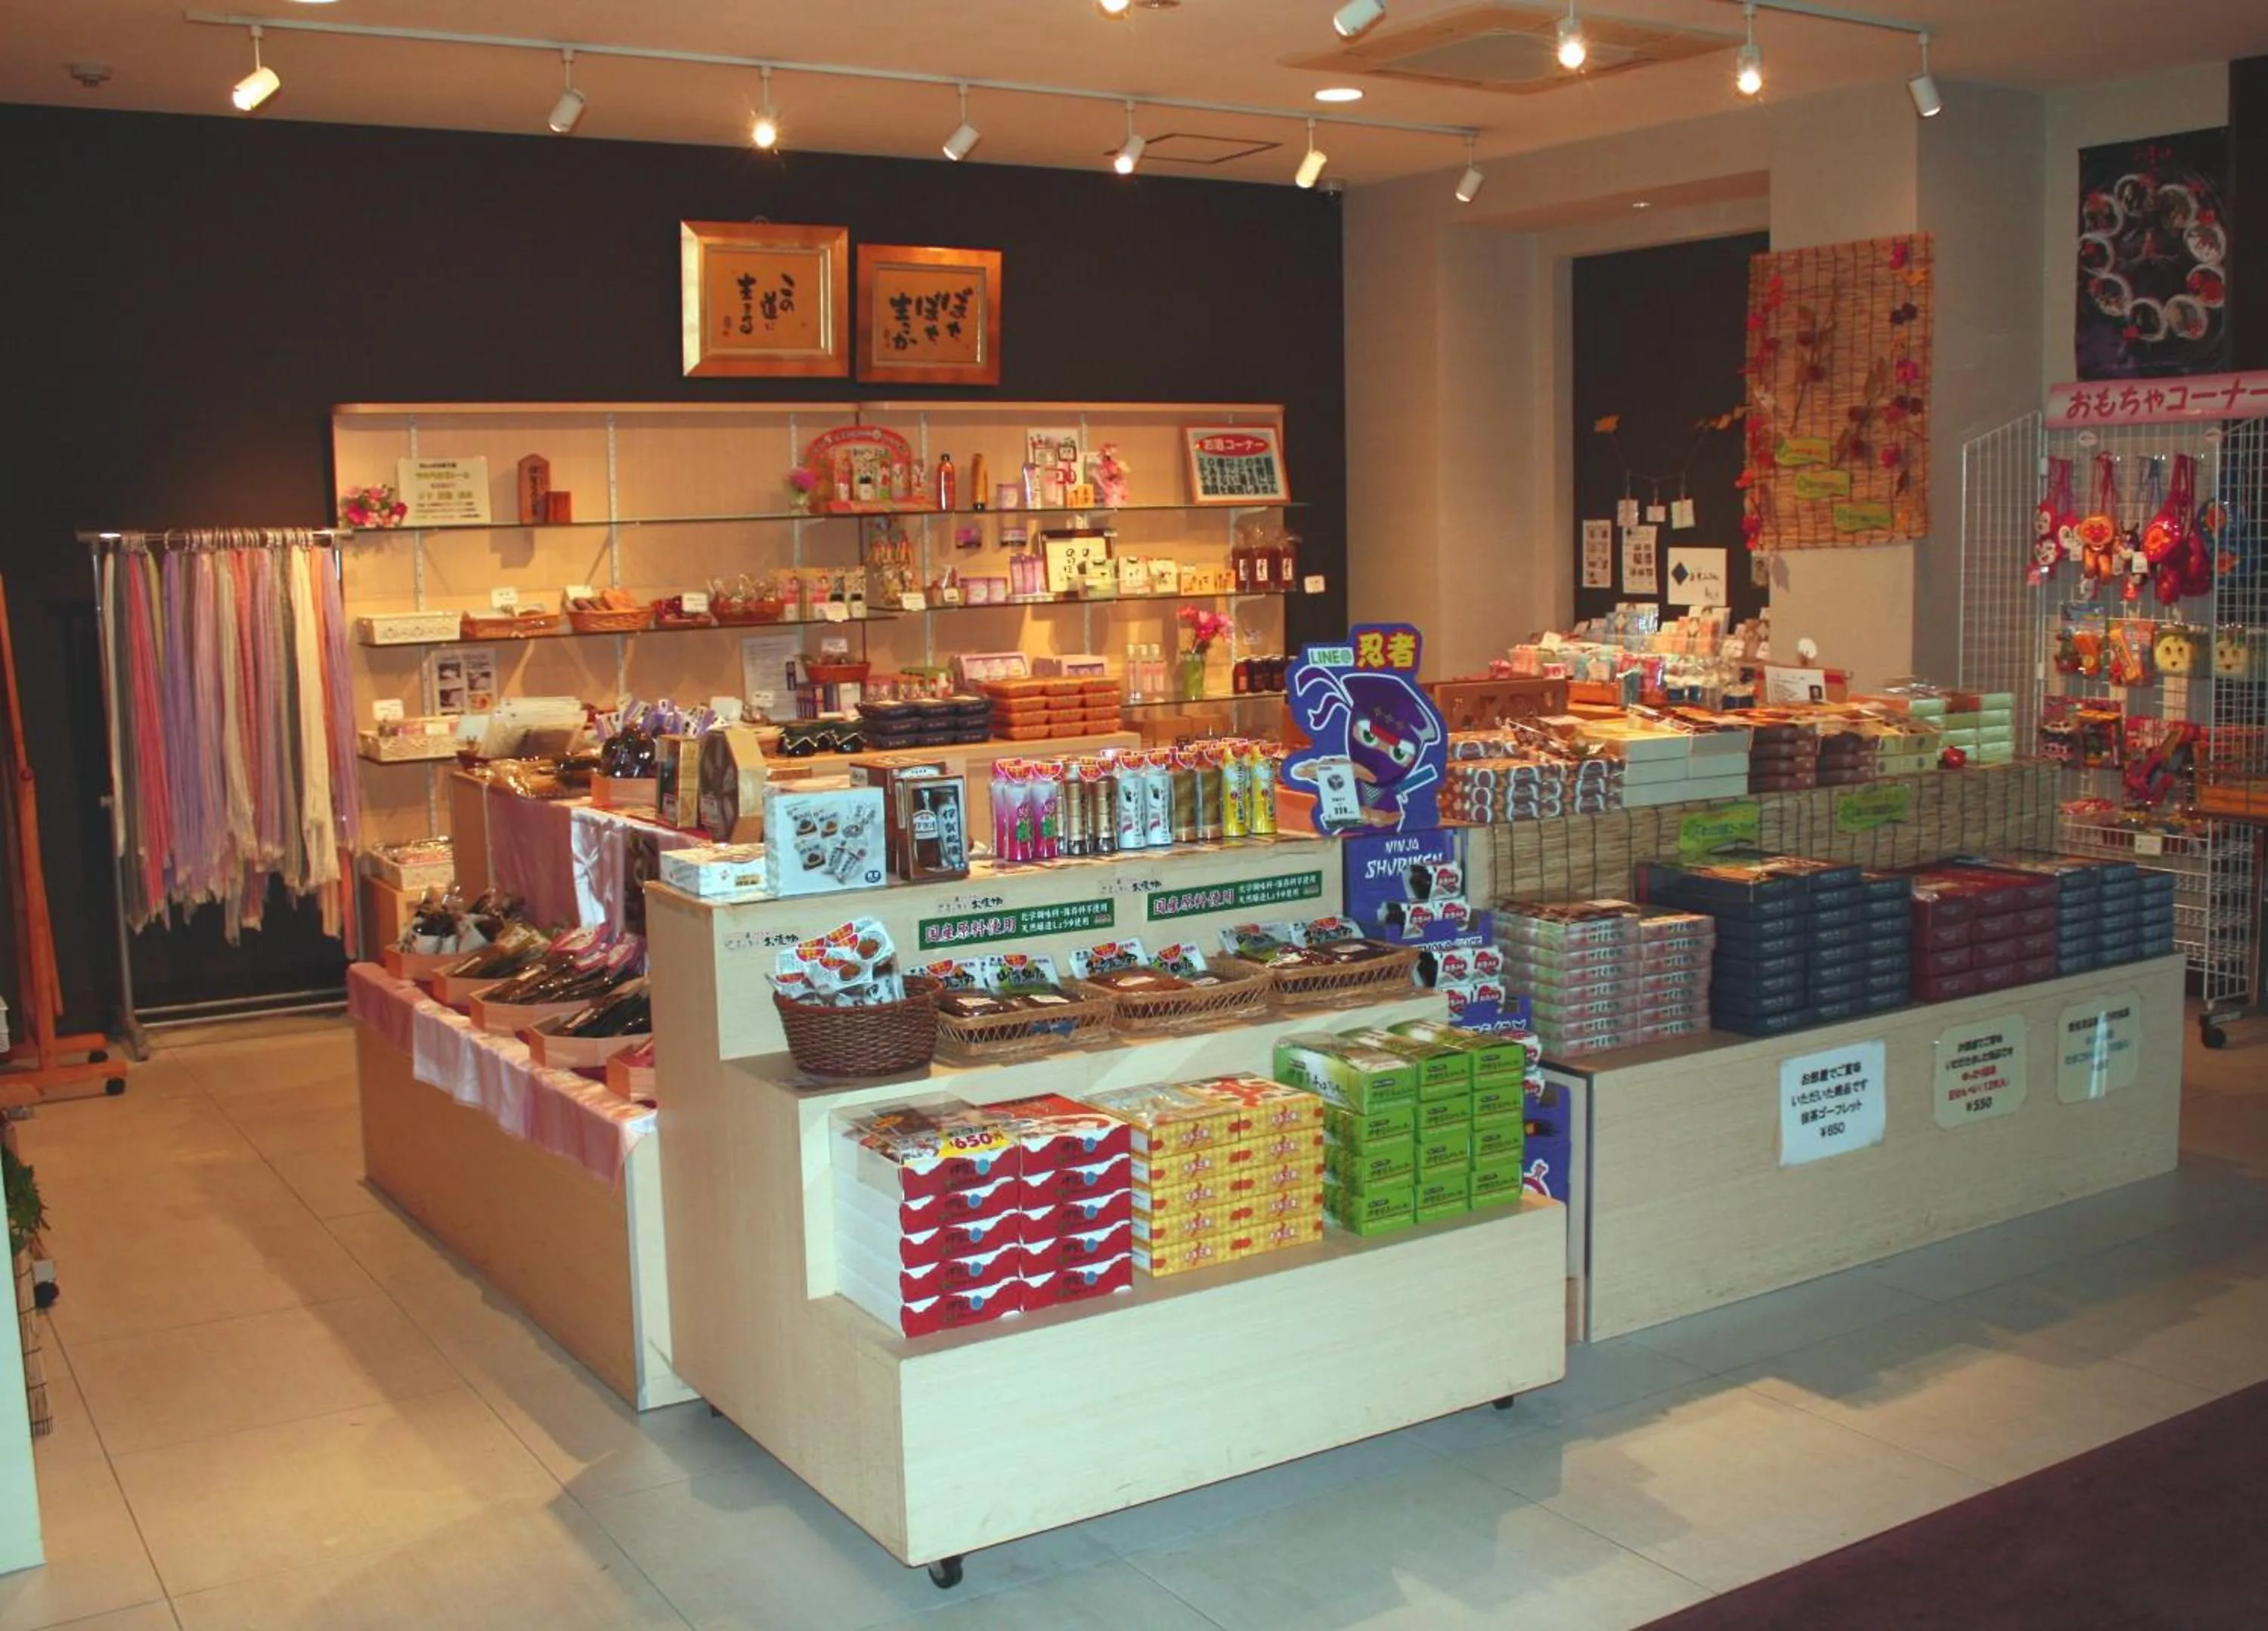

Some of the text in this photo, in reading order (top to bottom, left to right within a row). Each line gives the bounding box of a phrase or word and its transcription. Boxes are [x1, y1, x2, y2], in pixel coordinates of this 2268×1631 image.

[2067, 379, 2268, 419] おもちゃコーナー
[1358, 633, 1416, 668] 忍者
[1385, 837, 1420, 854] NINJA
